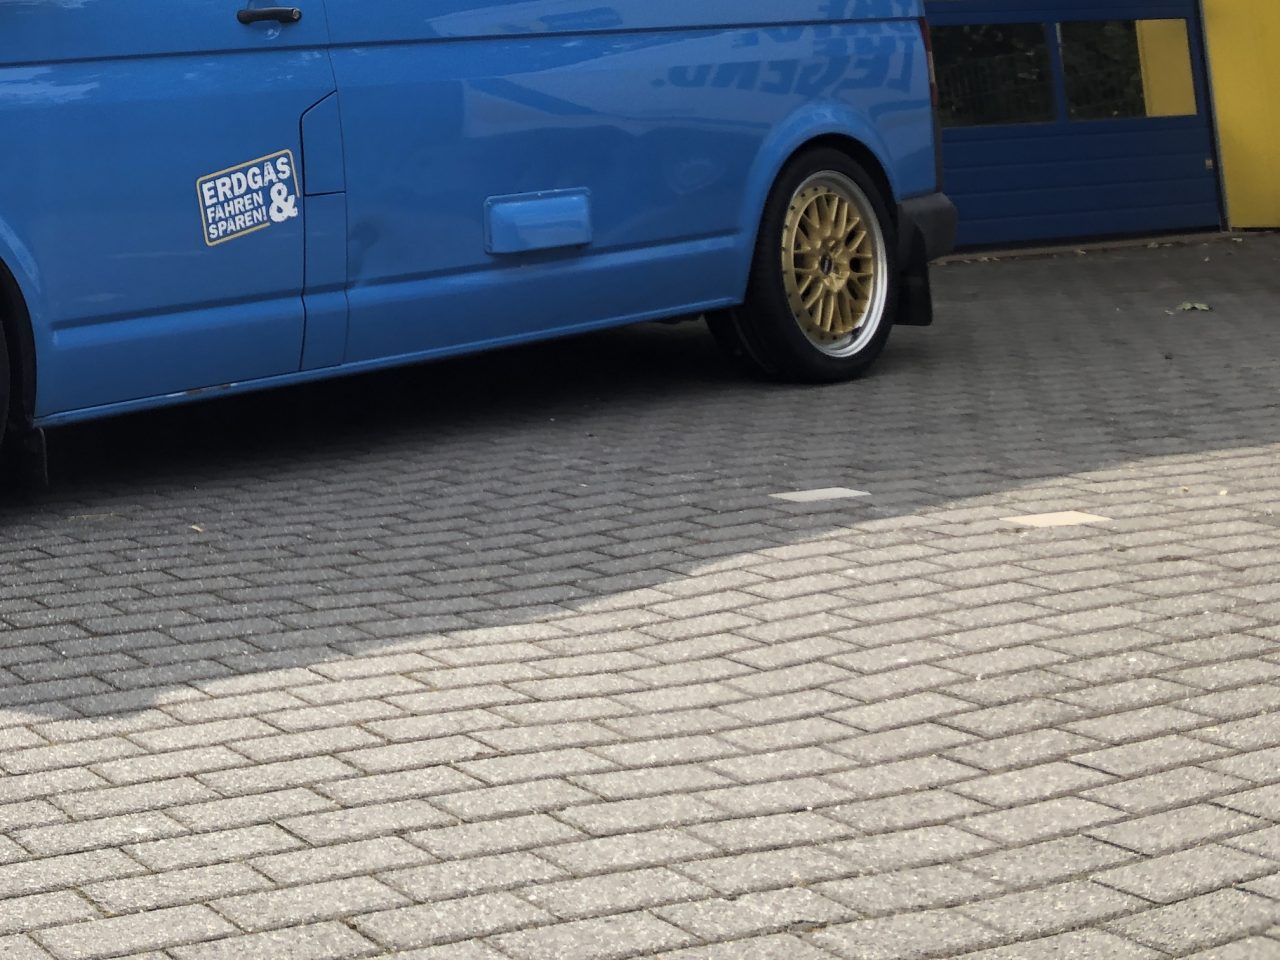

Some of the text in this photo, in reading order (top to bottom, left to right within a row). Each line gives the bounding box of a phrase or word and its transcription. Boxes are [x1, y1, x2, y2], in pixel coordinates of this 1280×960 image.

[202, 157, 291, 206] ERDGAS
[206, 182, 298, 223] FAHREN &
[209, 207, 268, 239] SPAREN!
